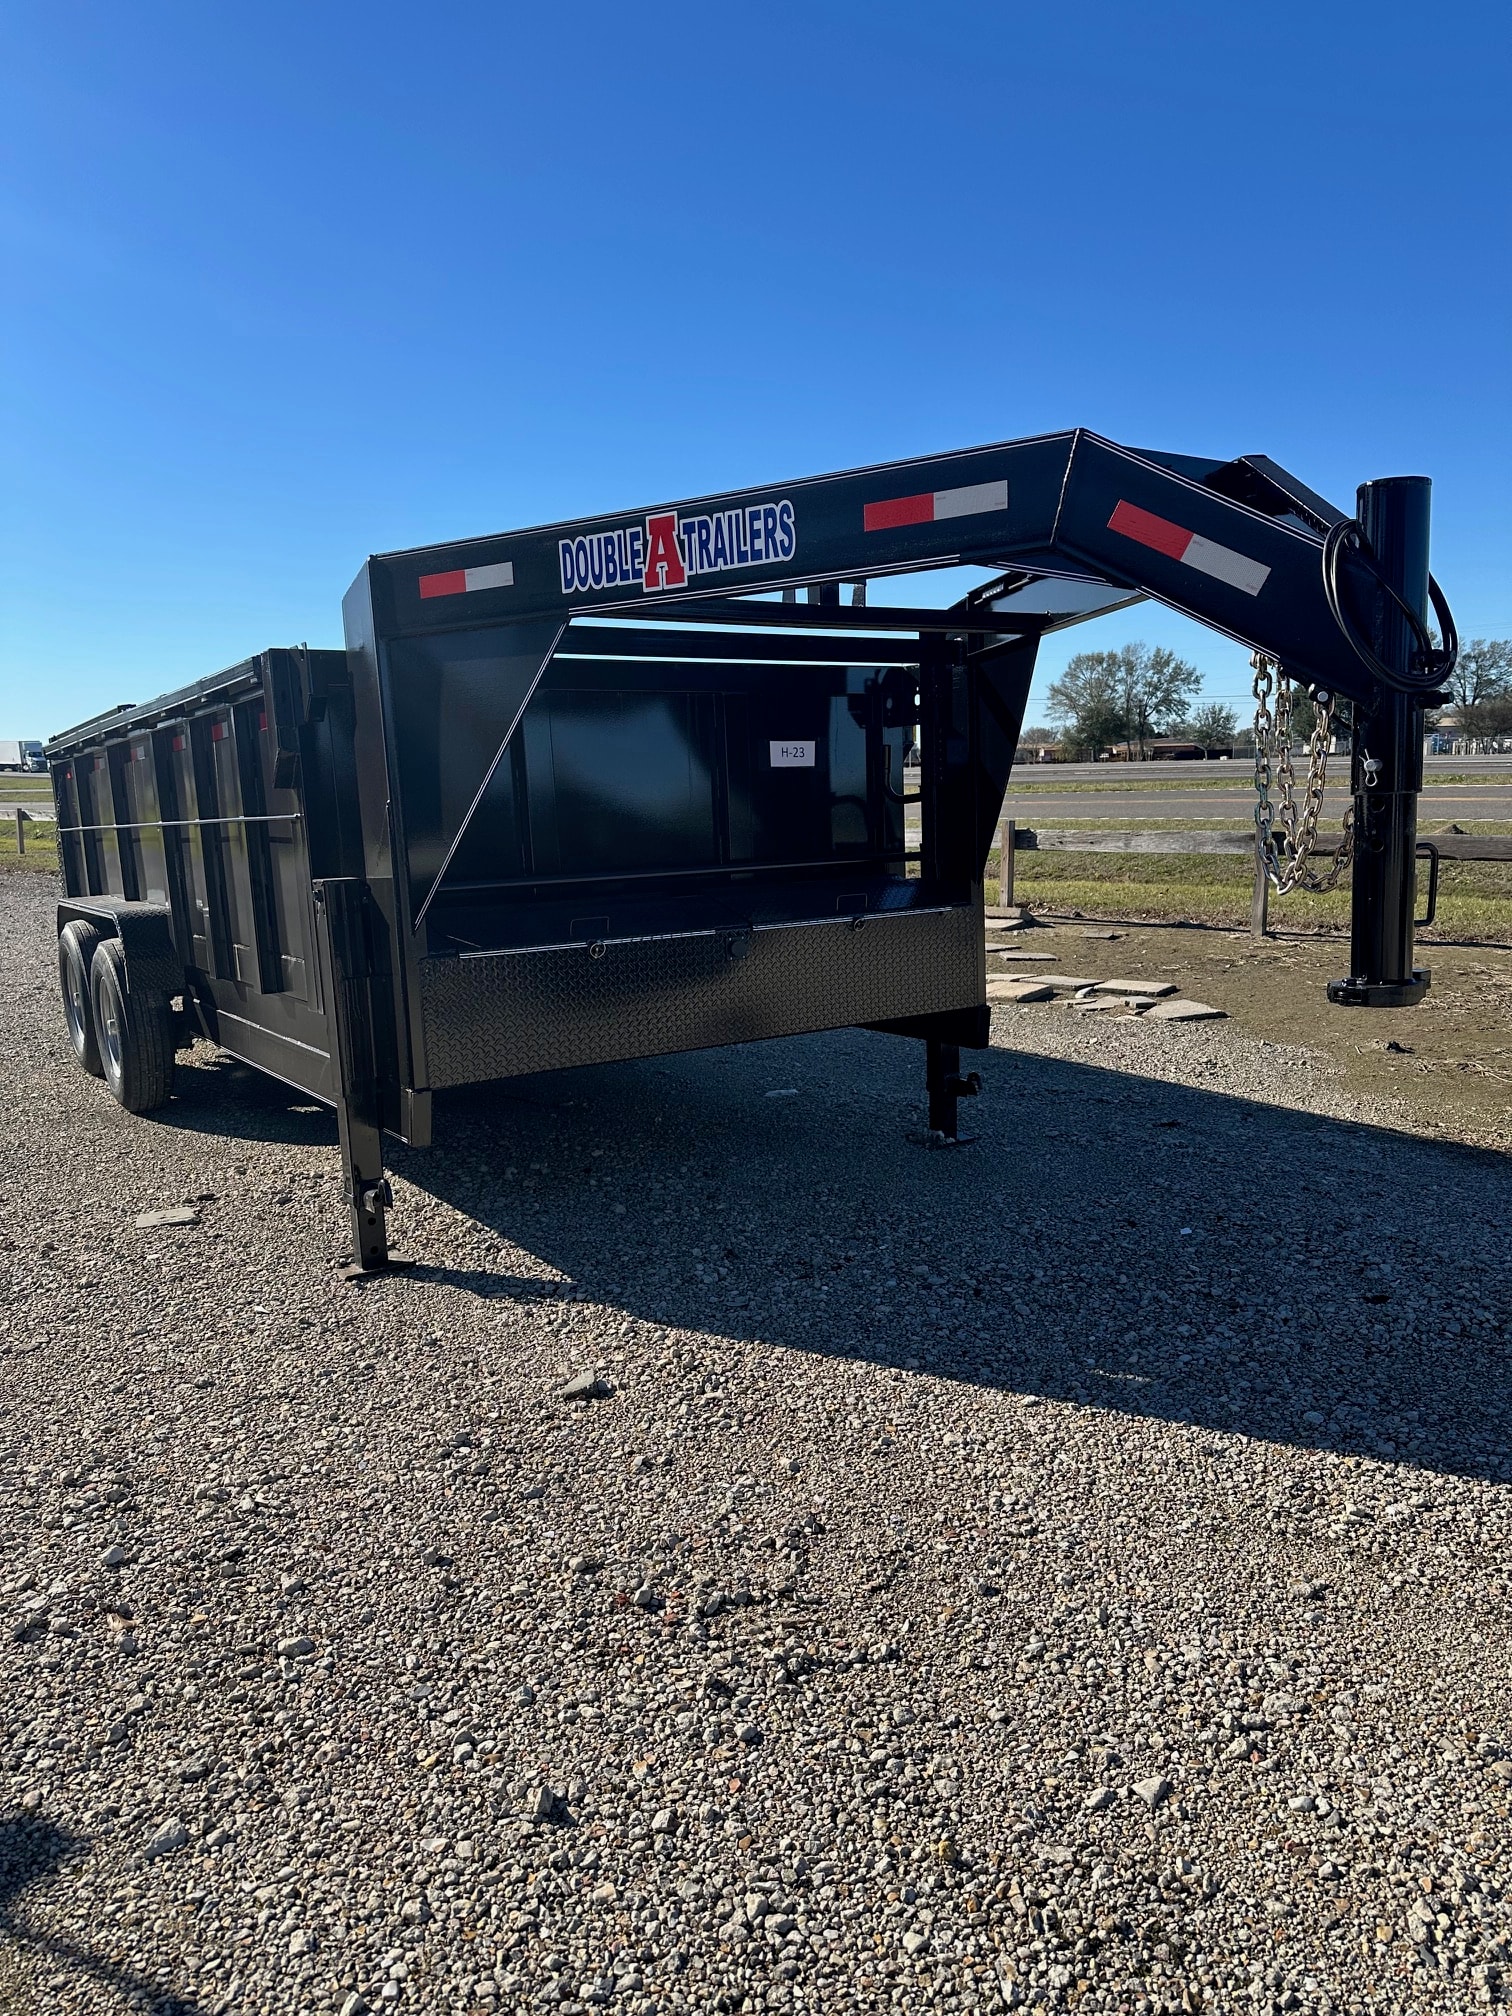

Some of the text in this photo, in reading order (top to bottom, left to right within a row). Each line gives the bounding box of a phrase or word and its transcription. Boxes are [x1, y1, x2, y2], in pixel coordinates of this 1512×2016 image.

[560, 501, 795, 593] DOUBLE A TRAILERS
[781, 746, 805, 758] H-23
